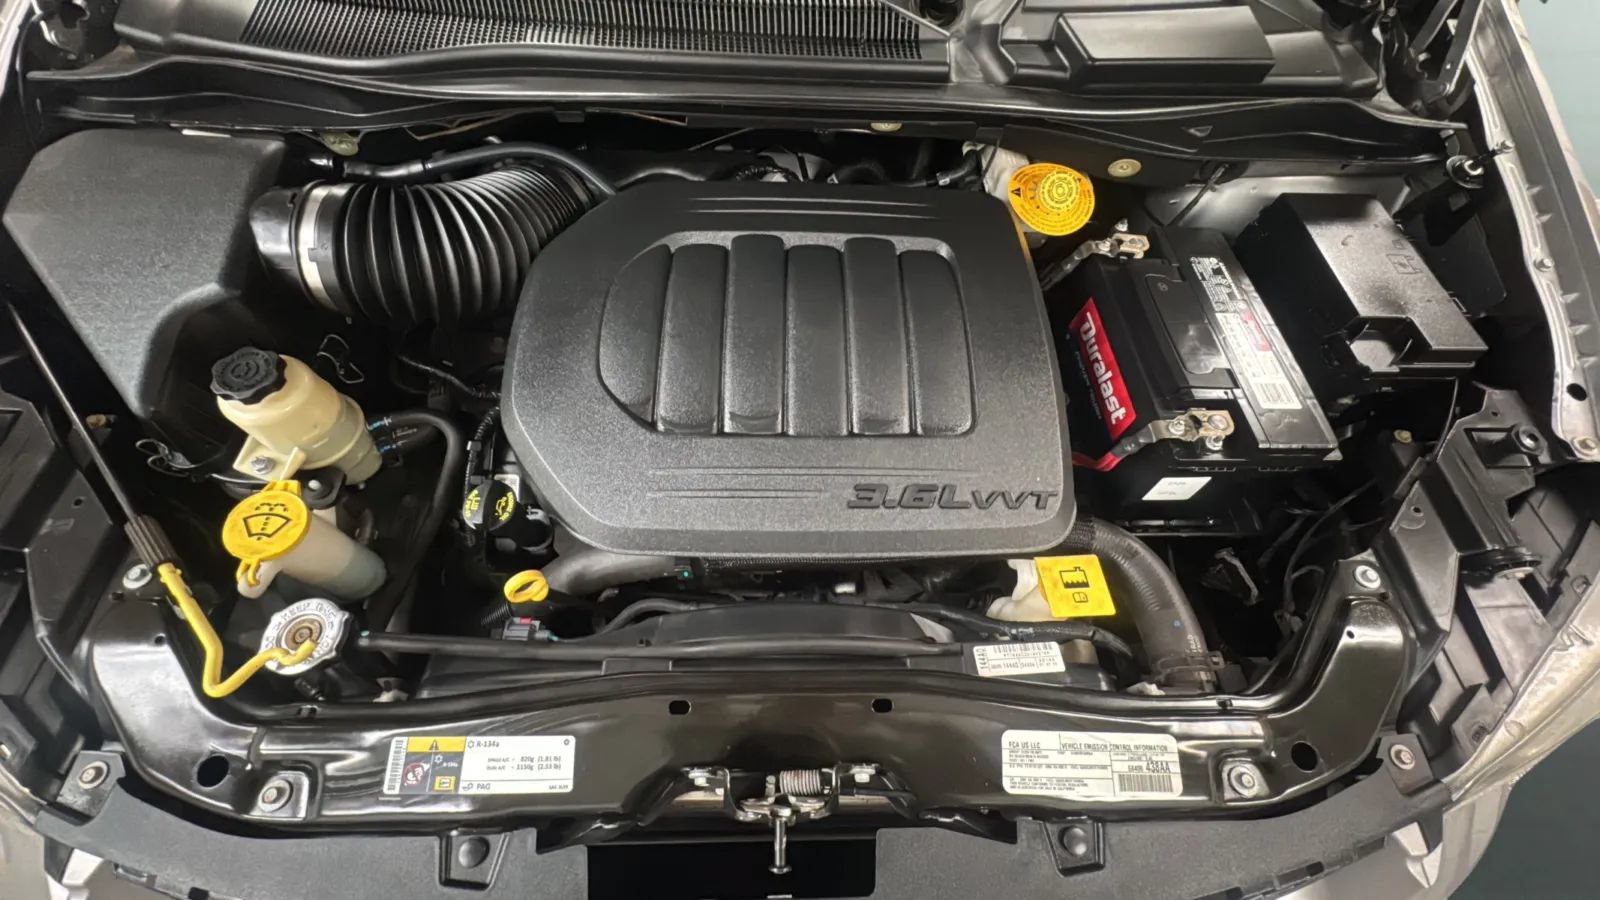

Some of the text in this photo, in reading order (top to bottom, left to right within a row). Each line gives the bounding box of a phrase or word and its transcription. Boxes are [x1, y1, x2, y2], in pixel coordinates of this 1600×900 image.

[1079, 311, 1128, 425] Duralast
[847, 483, 1058, 510] 3.6L VVT
[476, 740, 500, 748] R-134a
[1021, 741, 1030, 749] US
[1109, 744, 1132, 752] CONTROL
[1146, 761, 1172, 774] 438AA
